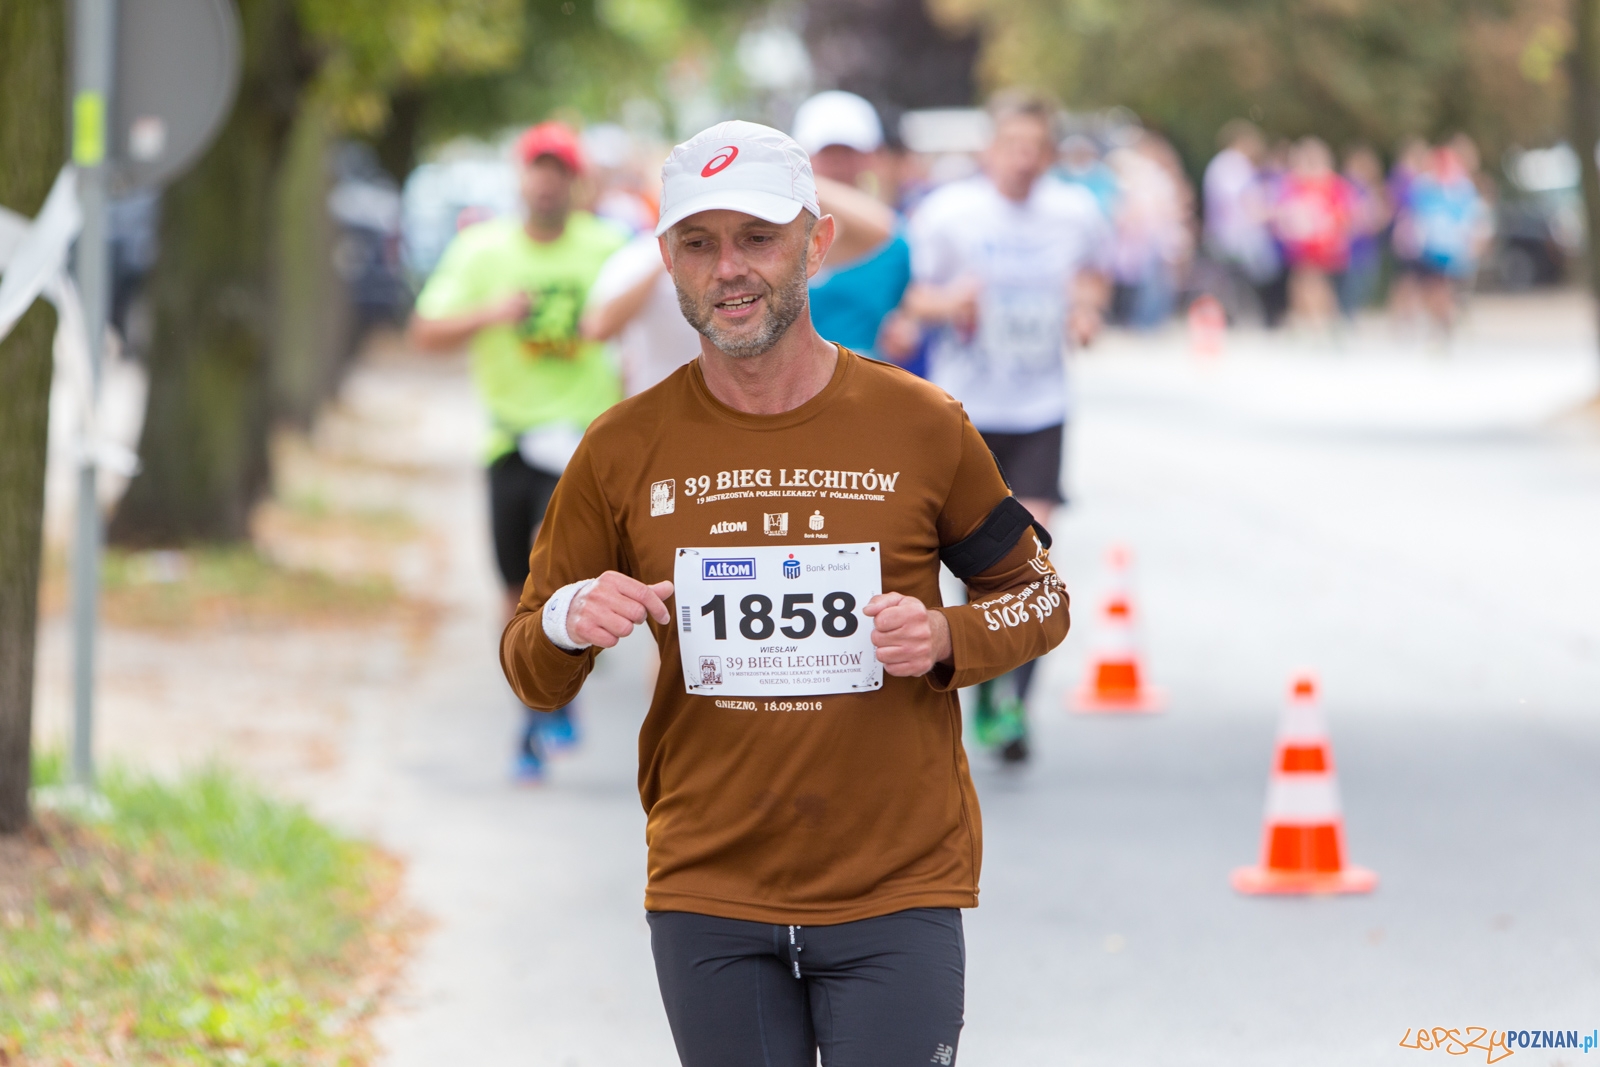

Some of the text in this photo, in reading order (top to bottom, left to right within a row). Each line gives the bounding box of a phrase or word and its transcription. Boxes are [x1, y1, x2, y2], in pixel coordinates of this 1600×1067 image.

[684, 468, 900, 497] 39 BIEG LECHITÓW
[696, 489, 885, 505] 19 MISTRZOSTWA POLSKI LEKARZY W PÓŁMARATONIE
[806, 562, 851, 573] Bank Polski
[701, 591, 859, 640] 1858
[760, 645, 798, 654] WIESŁAW
[726, 657, 743, 670] 39
[748, 656, 783, 669] BIEG
[787, 651, 863, 668] LECHITÓW
[793, 676, 831, 685] 18.09.2016
[764, 701, 823, 712] 18.09.2016
